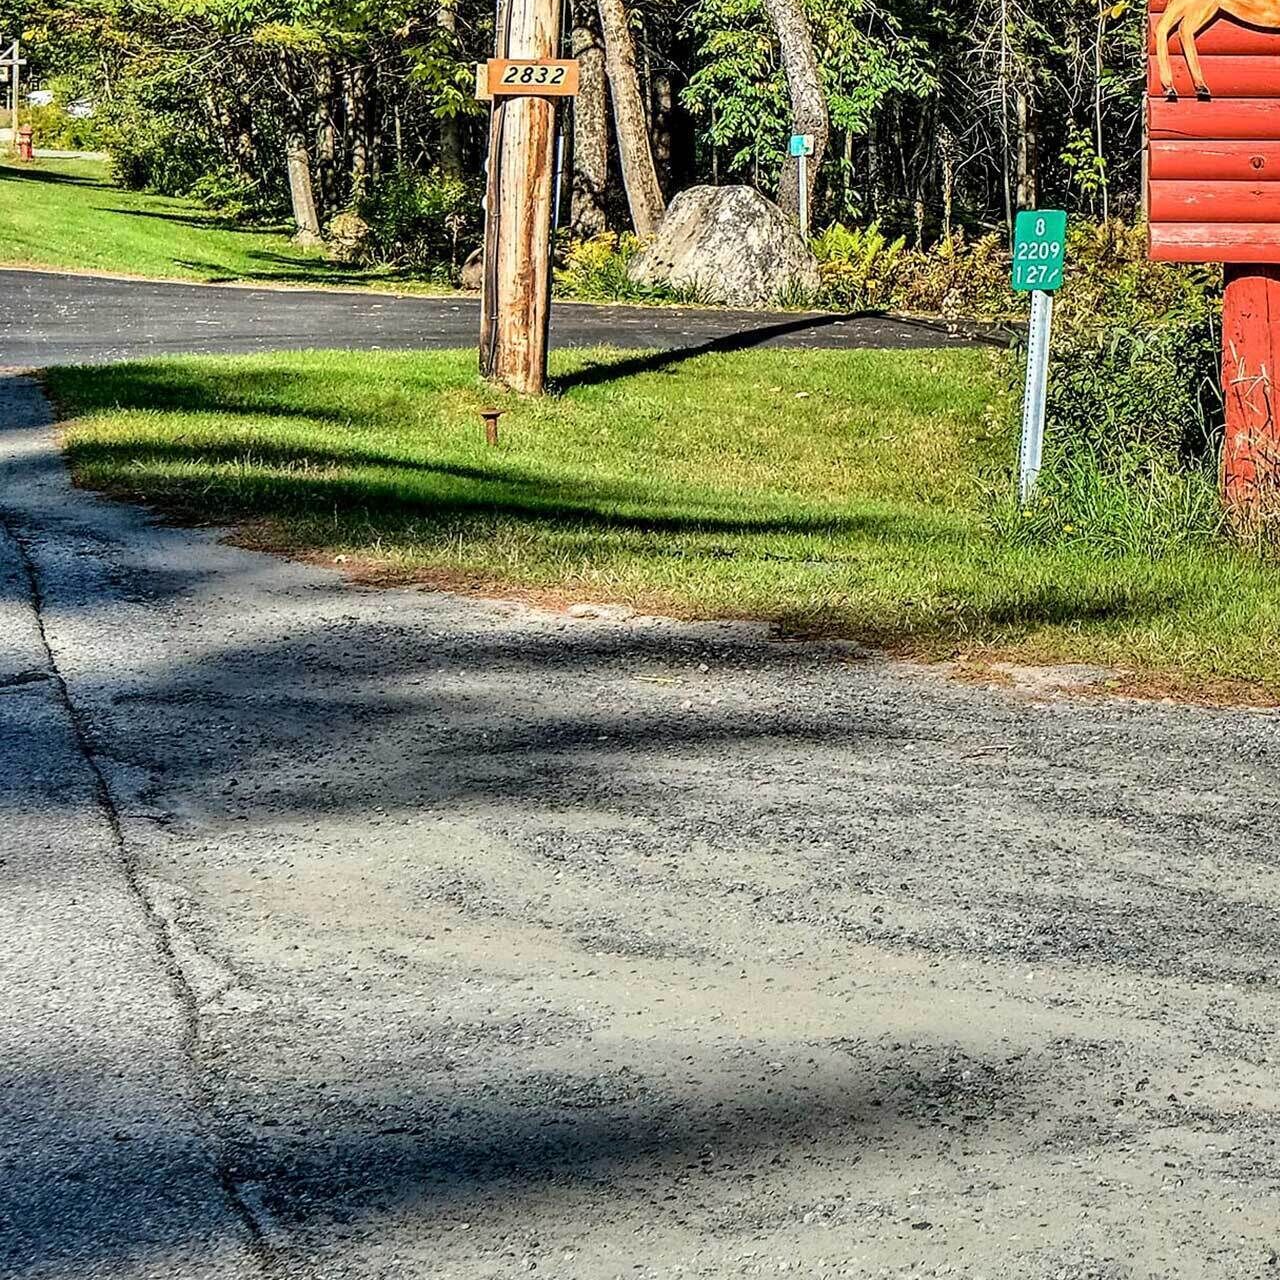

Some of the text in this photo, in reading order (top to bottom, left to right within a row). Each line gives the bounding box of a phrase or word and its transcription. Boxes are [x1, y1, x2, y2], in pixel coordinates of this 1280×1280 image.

[503, 66, 565, 84] 2832
[1035, 218, 1045, 236] 8
[1018, 241, 1060, 260] 2209
